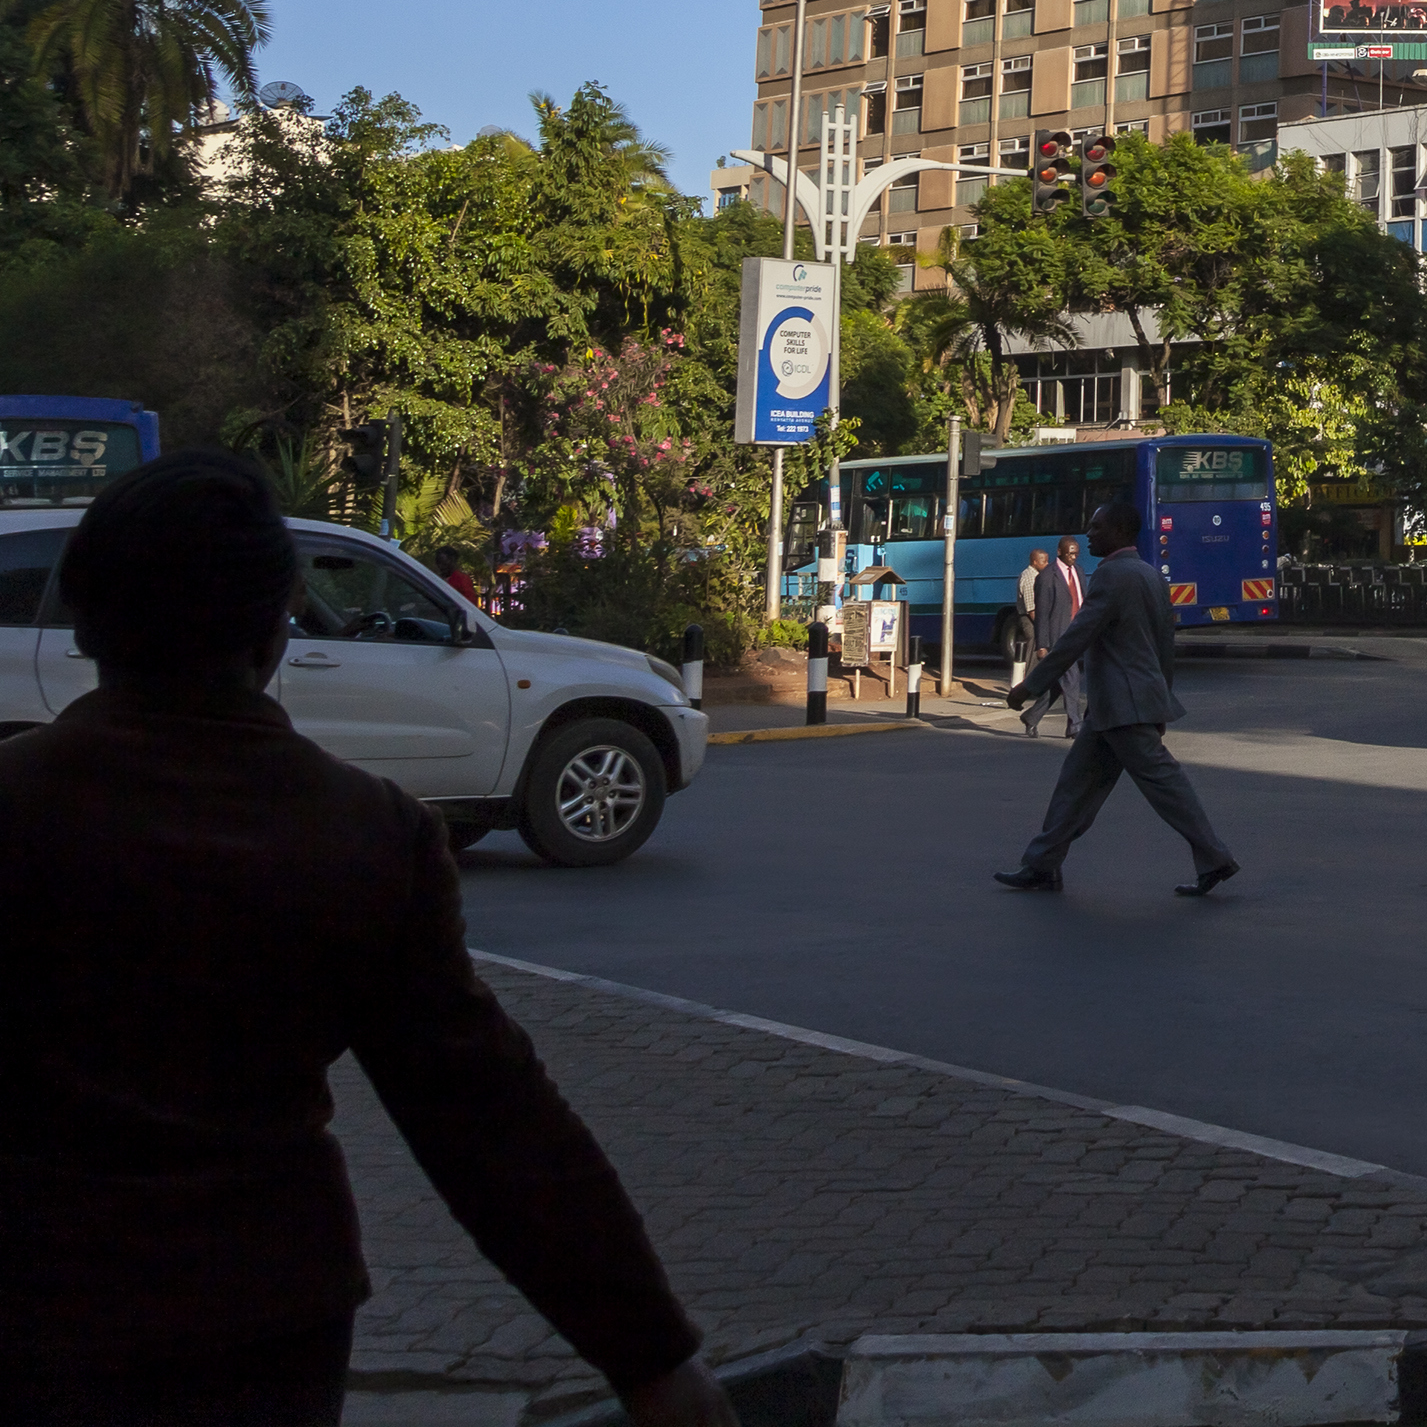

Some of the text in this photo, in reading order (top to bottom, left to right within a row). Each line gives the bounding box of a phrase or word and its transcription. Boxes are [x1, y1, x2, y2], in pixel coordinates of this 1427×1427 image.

[776, 283, 822, 293] computerpride
[780, 330, 811, 339] COMPUTER
[796, 347, 808, 355] LIFE
[794, 364, 811, 374] ICDL
[770, 409, 814, 418] ICEA BUILDING
[1196, 451, 1244, 470] KBS
[1202, 535, 1230, 543] ISUZU
